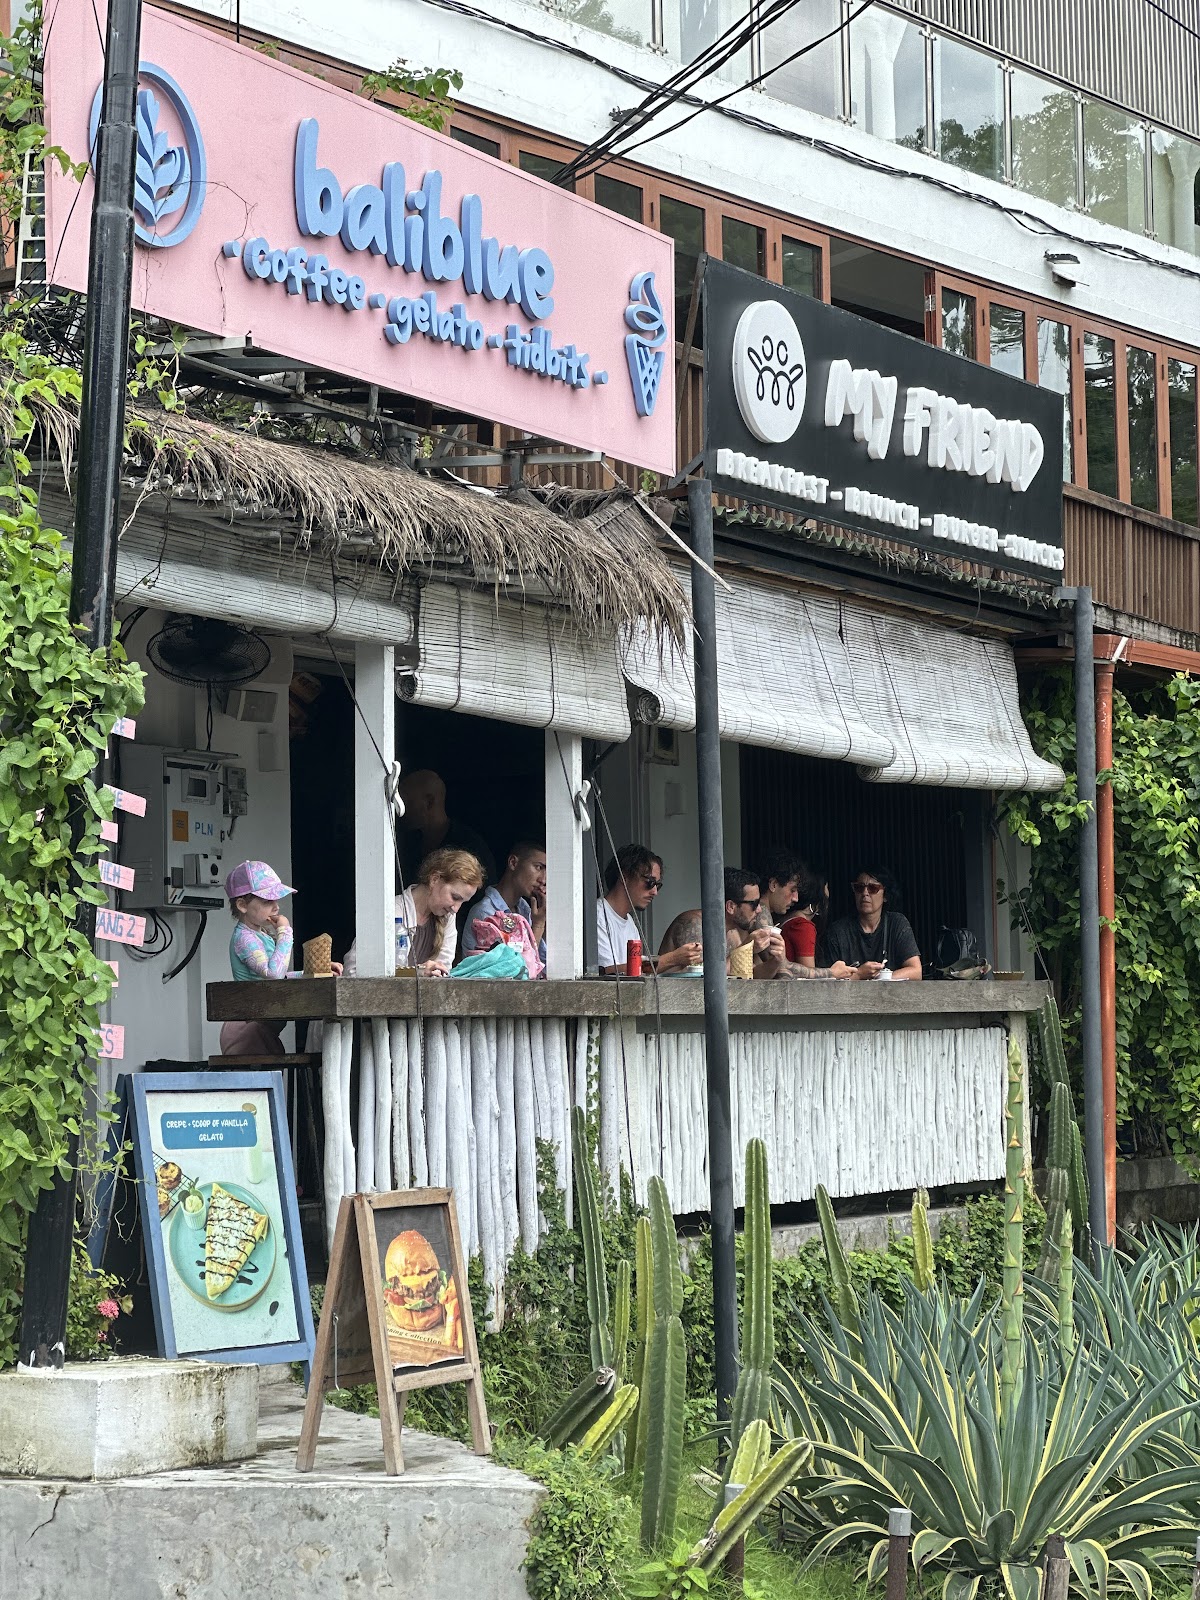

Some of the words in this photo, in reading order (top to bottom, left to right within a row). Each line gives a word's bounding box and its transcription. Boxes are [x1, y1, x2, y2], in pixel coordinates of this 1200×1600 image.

[295, 118, 554, 320] baliblue
[385, 291, 484, 350] gelato
[505, 324, 590, 389] tidbits
[825, 359, 897, 459] MY
[903, 387, 1044, 492] FRIEND
[717, 448, 829, 503] BREAKFAST
[845, 487, 919, 530] BRUNCH
[933, 514, 998, 552] BURGER
[195, 822, 213, 836] PLN
[127, 916, 136, 938] 2
[166, 1120, 187, 1128] CREPE
[192, 1119, 211, 1128] SCOOP
[212, 1119, 220, 1127] OF
[221, 1119, 248, 1127] VANILLA
[199, 1133, 224, 1142] GELATO
